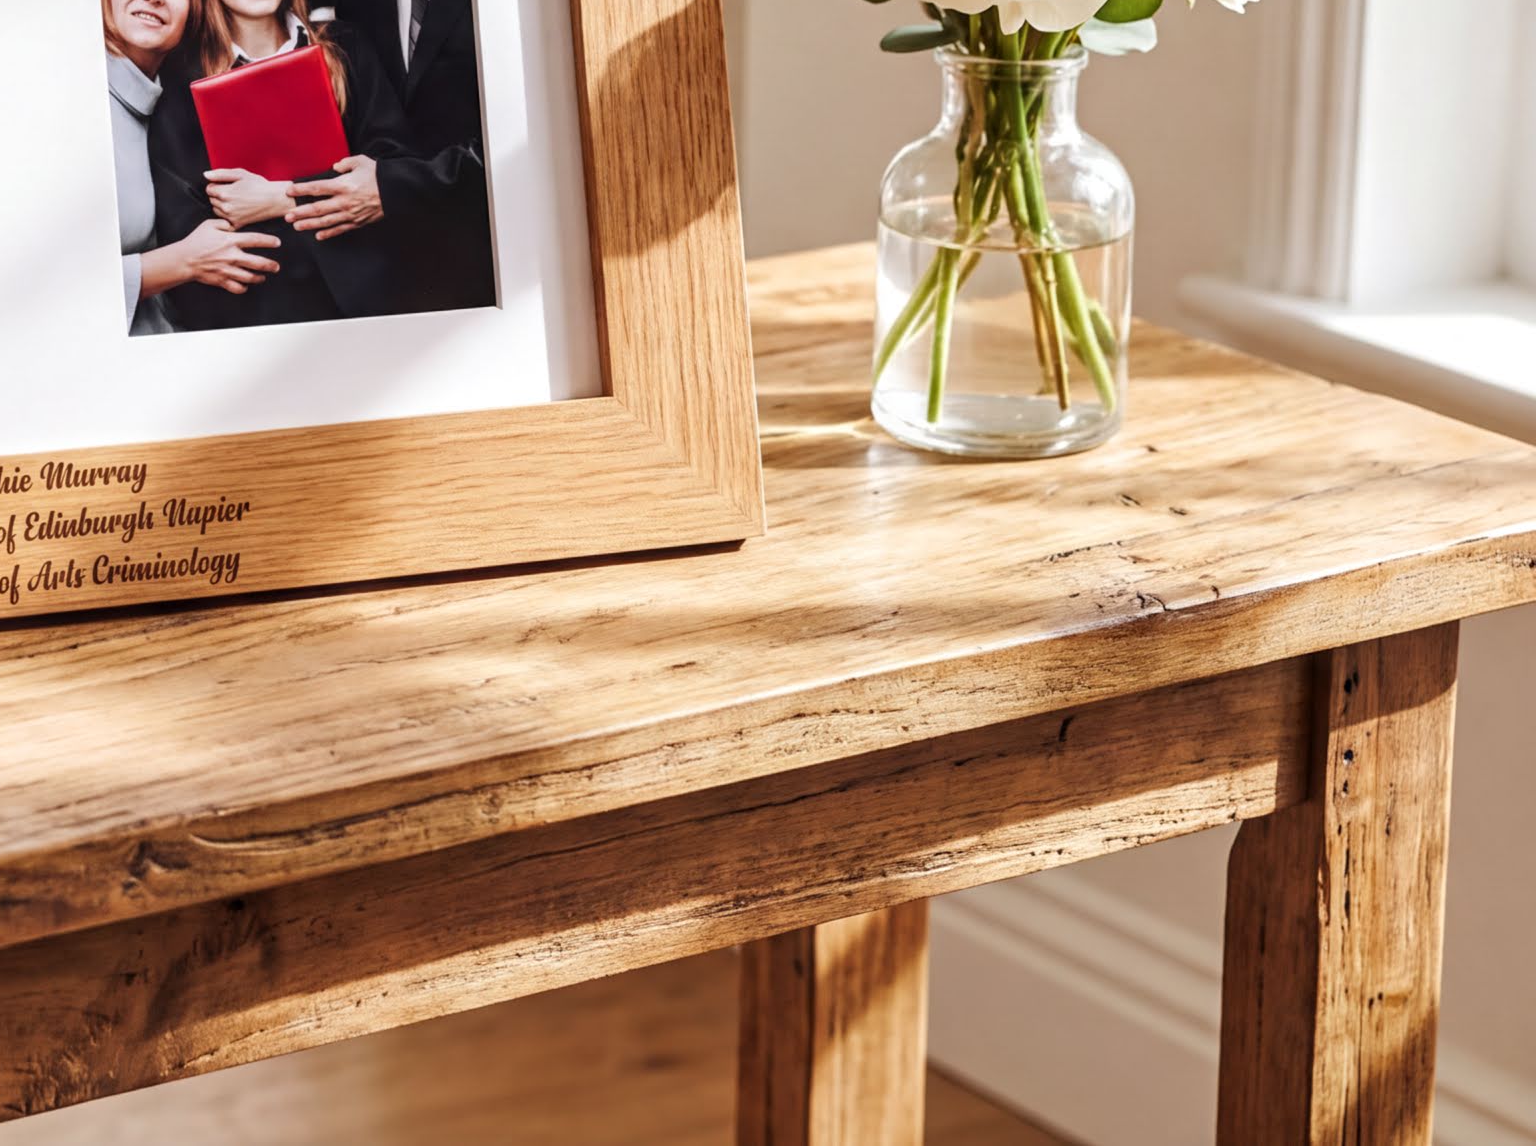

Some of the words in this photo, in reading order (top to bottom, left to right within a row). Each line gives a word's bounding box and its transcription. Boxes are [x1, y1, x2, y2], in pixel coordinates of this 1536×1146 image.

[39, 461, 148, 494] Murray
[24, 501, 154, 544] Edinburgh
[27, 558, 86, 592] Arts
[92, 547, 241, 585] Criminology
